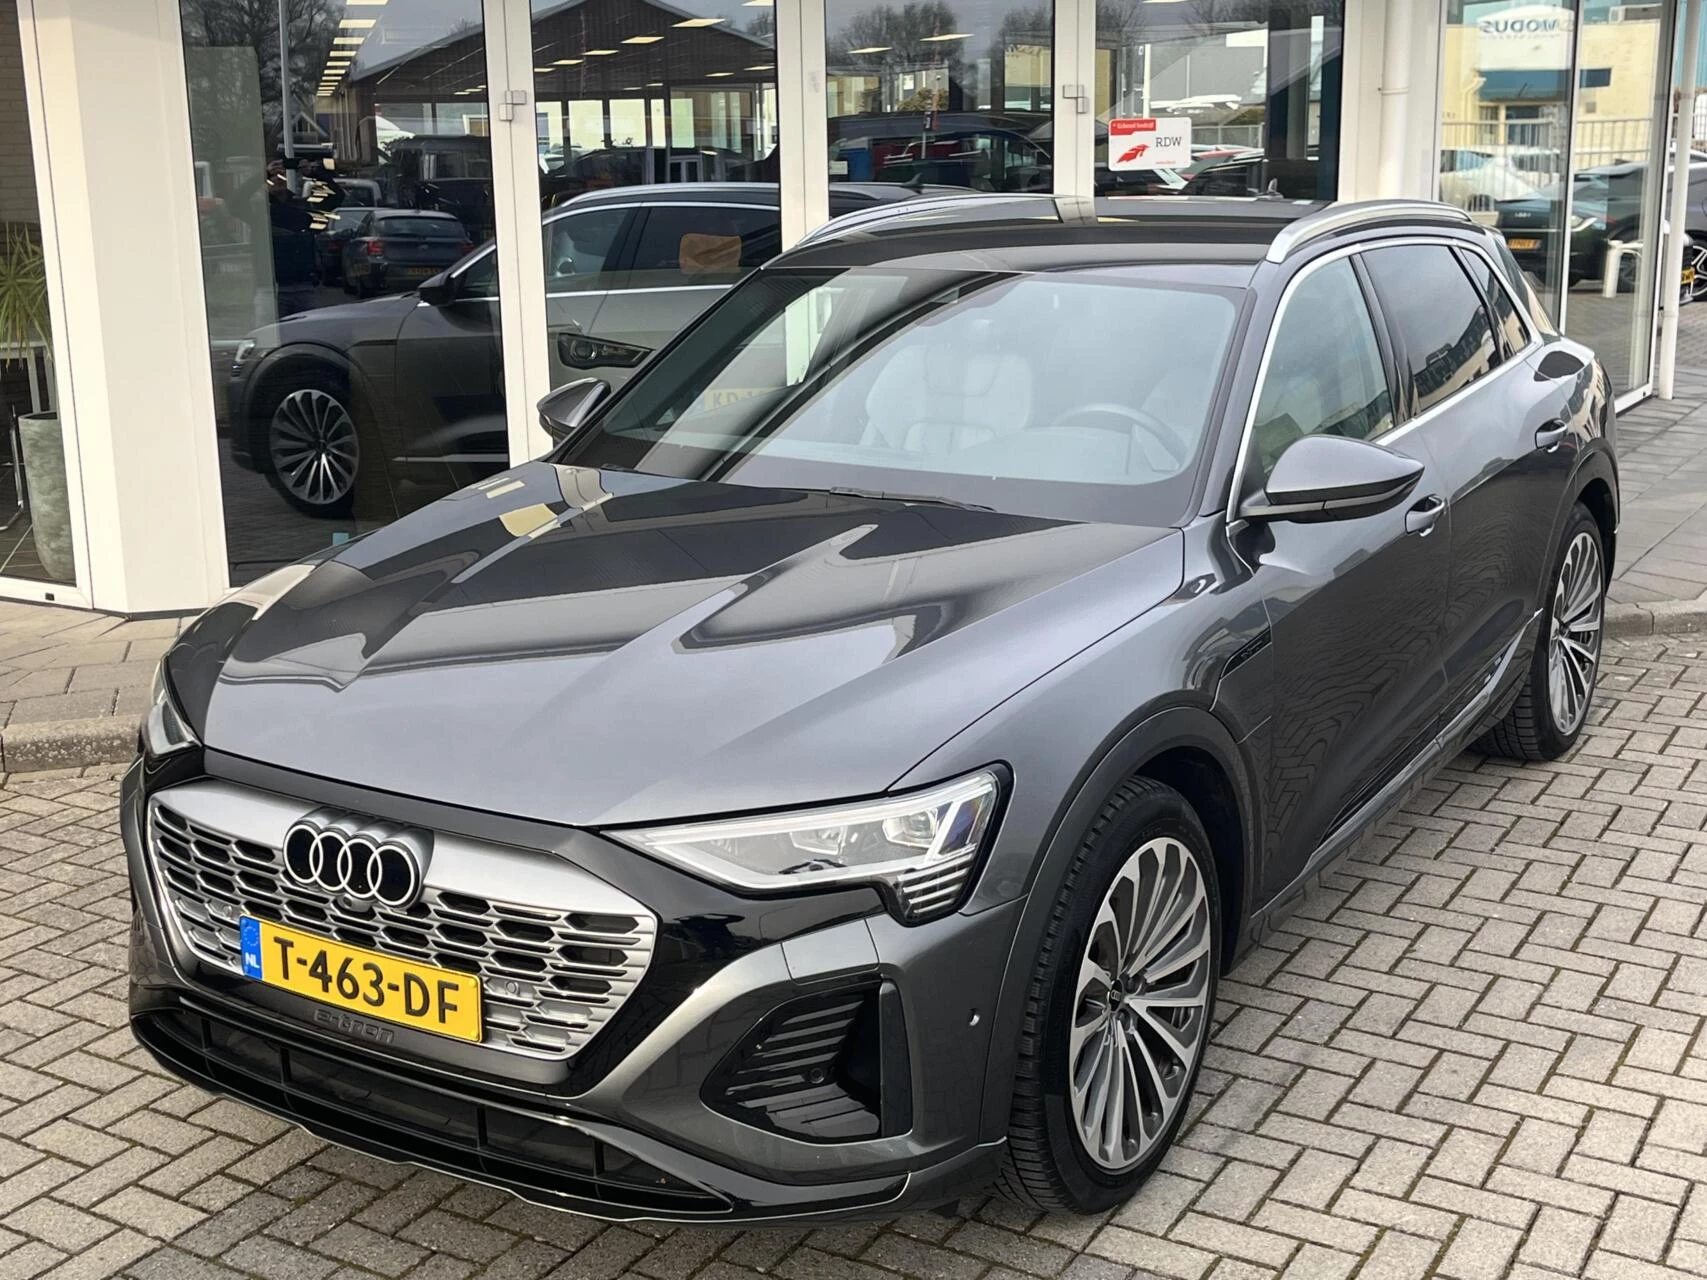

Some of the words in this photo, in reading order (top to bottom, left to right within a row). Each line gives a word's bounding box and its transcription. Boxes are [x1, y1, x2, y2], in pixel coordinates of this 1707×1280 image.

[1155, 136, 1182, 148] RDW
[244, 951, 261, 969] NL
[273, 935, 460, 1024] T-463-DF
[313, 1008, 395, 1044] e-tron
